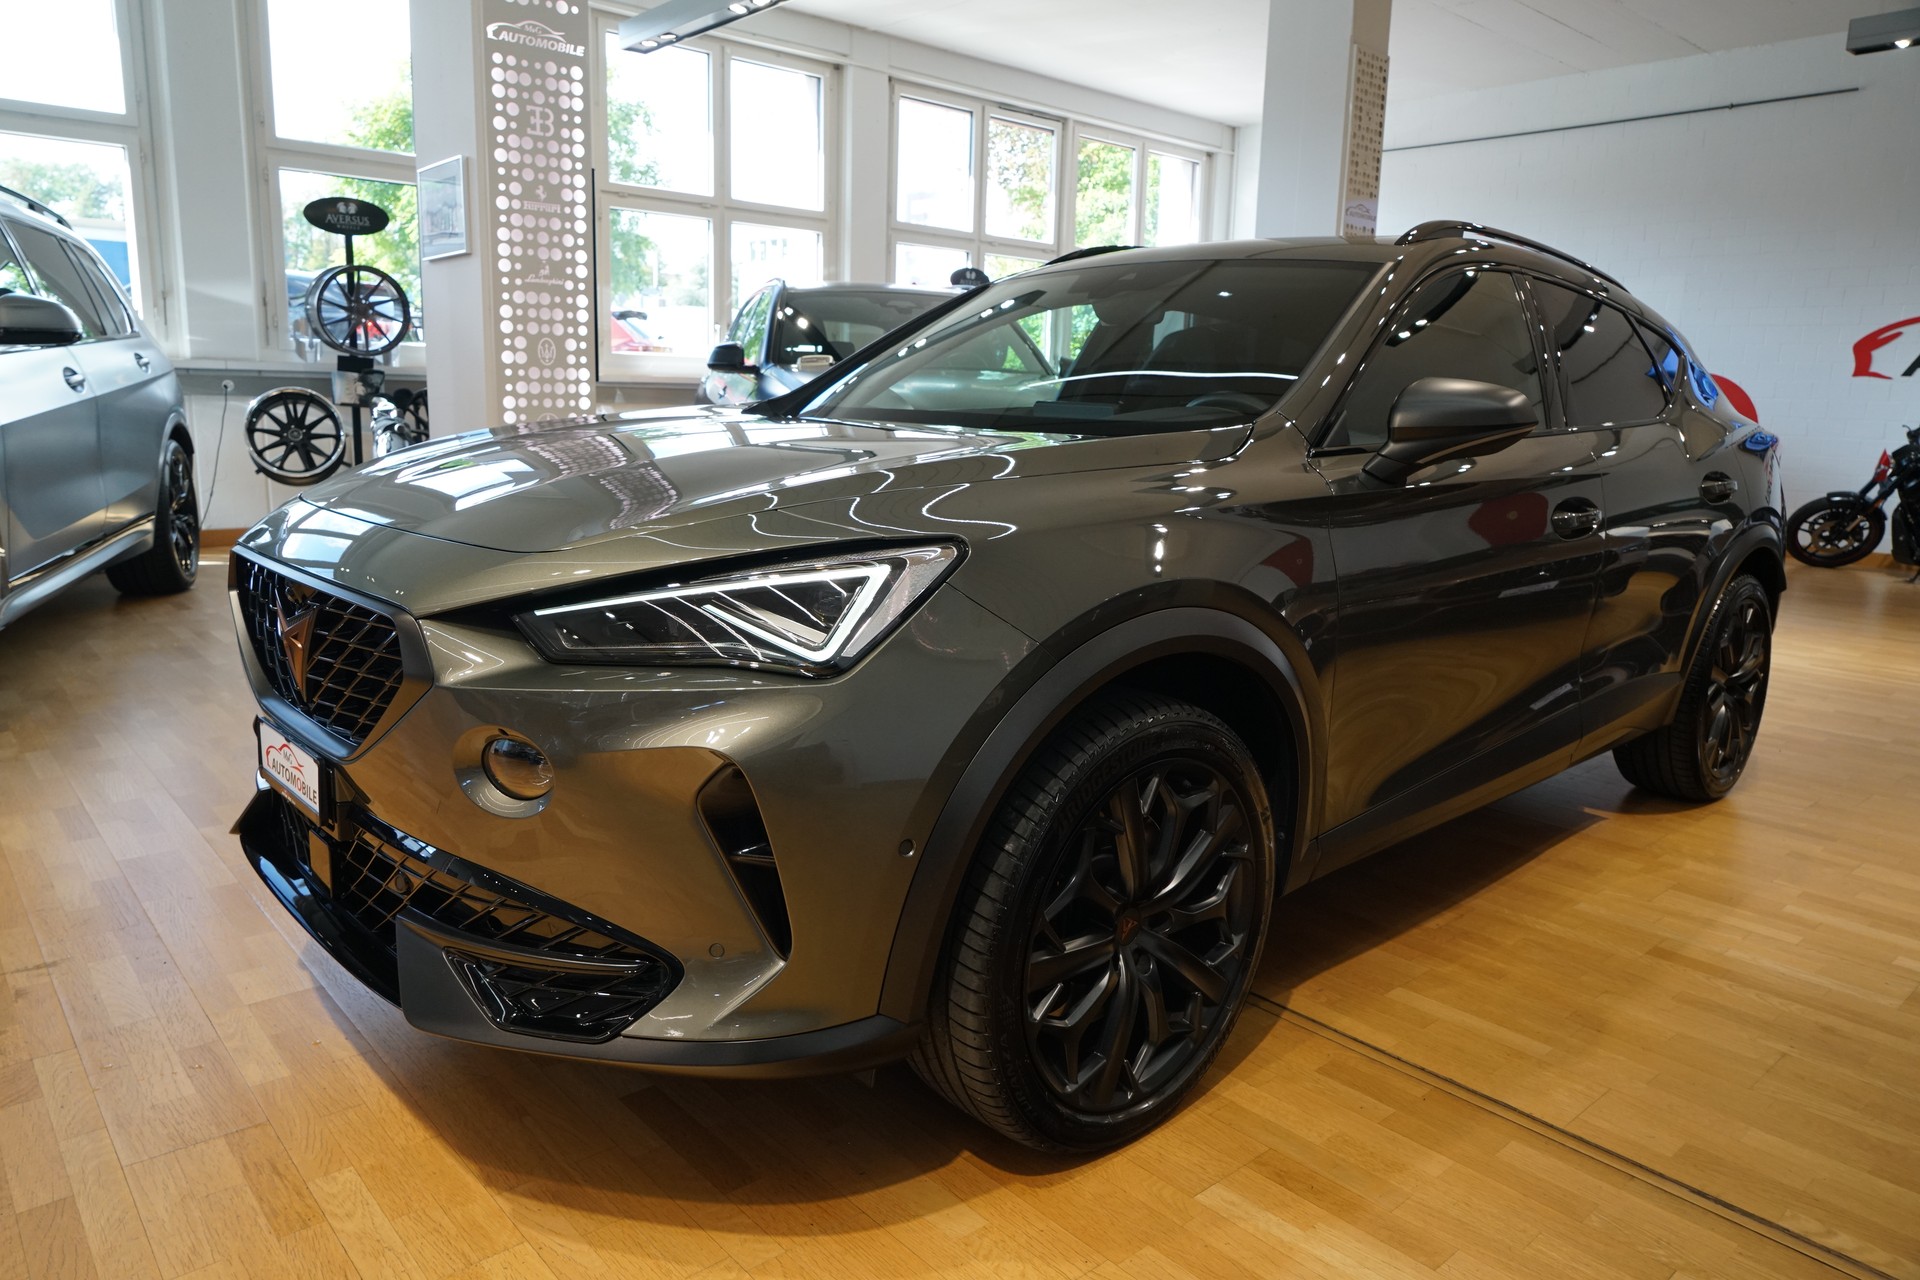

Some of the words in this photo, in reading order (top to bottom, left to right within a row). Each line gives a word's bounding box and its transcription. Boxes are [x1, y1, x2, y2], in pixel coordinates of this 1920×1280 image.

[499, 31, 585, 56] AUTOMOBILE
[325, 213, 370, 226] AVERSUS
[271, 758, 318, 805] AUTOMOBILE
